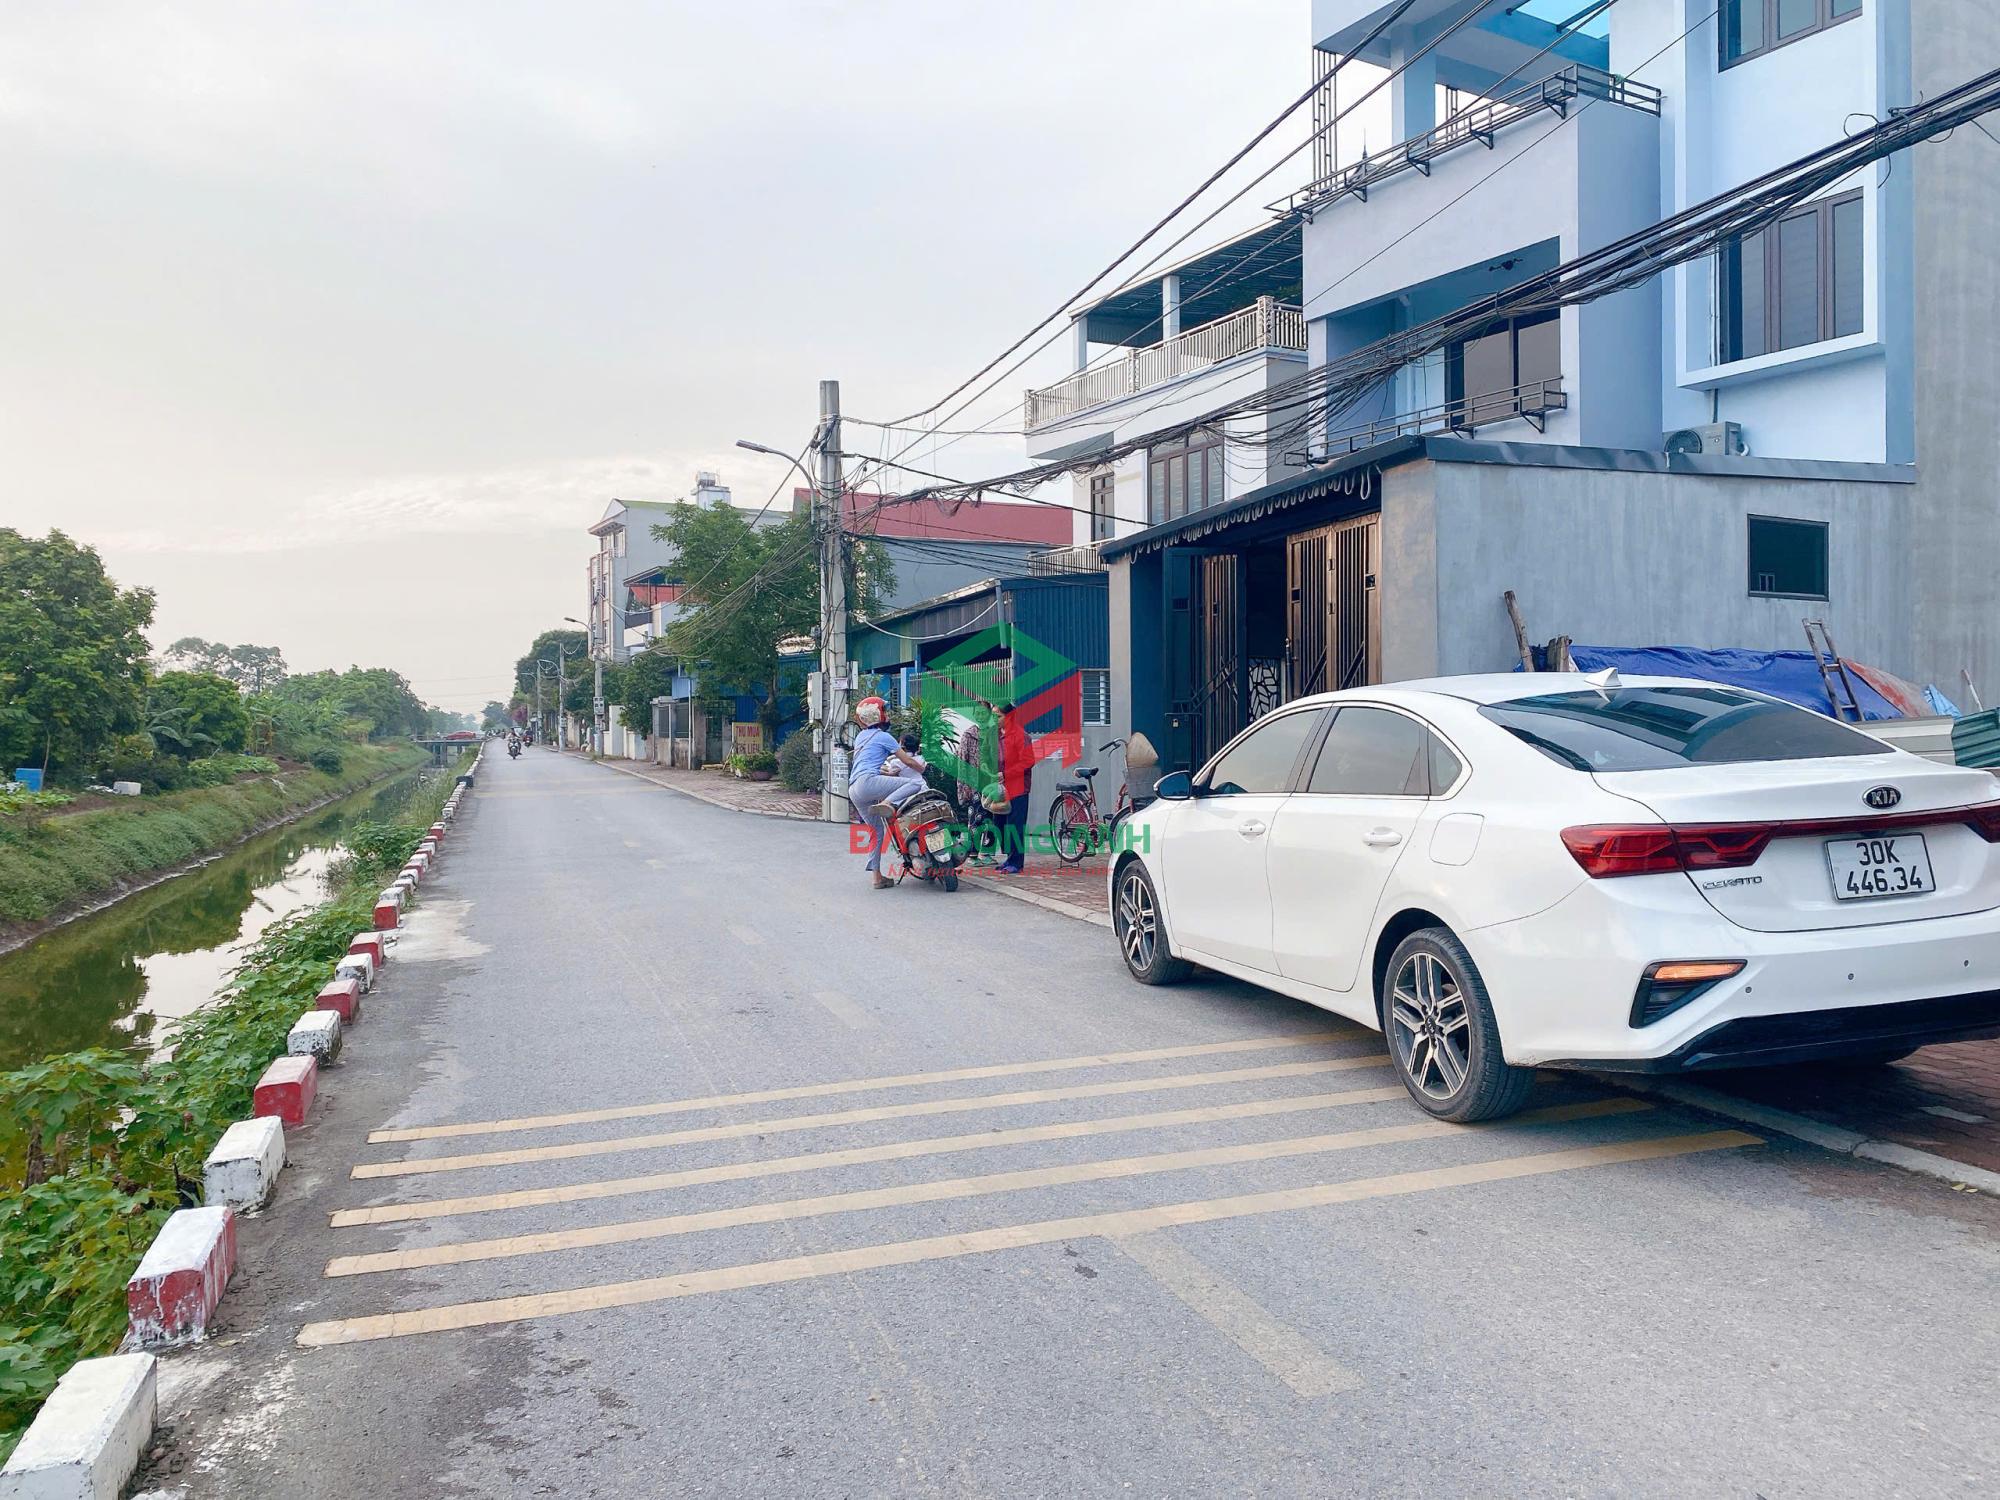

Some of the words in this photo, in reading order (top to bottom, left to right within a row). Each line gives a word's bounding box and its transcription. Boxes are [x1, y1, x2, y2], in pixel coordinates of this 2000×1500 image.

[1869, 788, 1899, 806] KIA
[1856, 839, 1900, 866] 30K
[1846, 865, 1923, 895] 446.34
